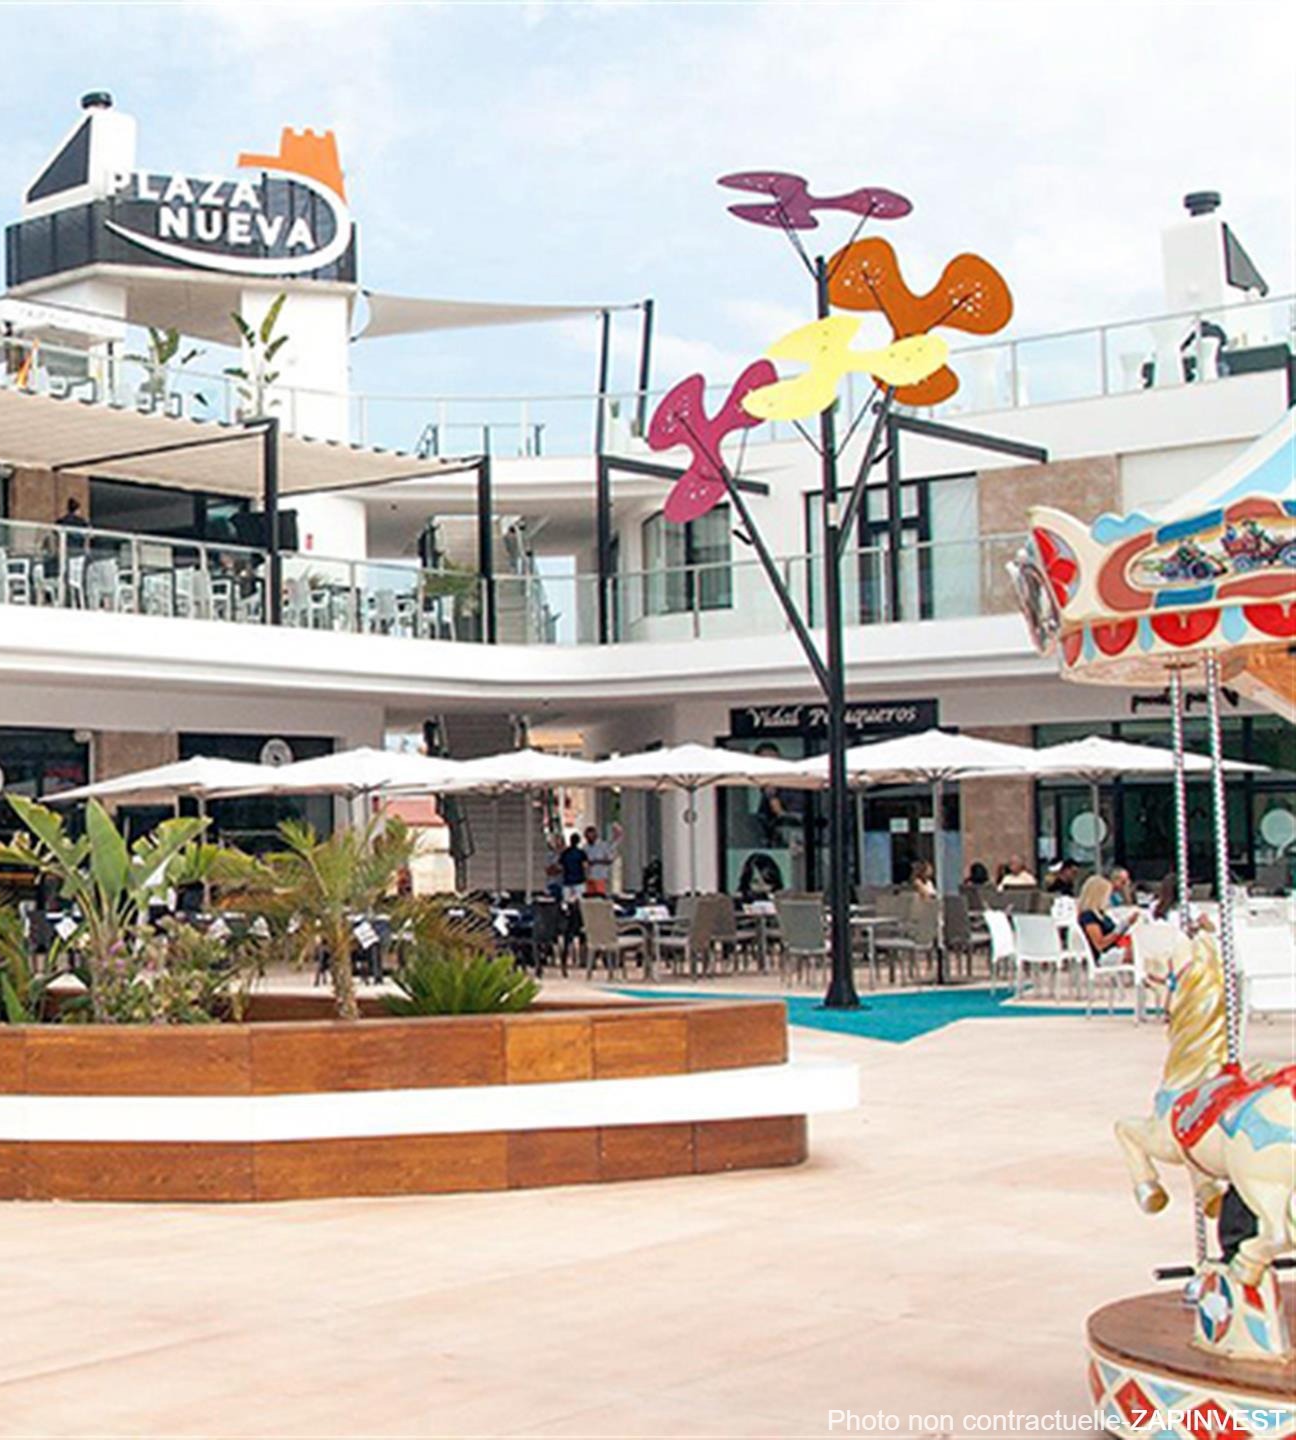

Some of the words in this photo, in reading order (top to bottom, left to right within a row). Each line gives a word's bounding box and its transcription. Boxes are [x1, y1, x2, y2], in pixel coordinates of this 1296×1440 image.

[107, 169, 261, 210] PLAZA
[159, 205, 316, 250] NUEVA
[747, 704, 803, 728] Vidal
[808, 706, 918, 730] Peuqueros
